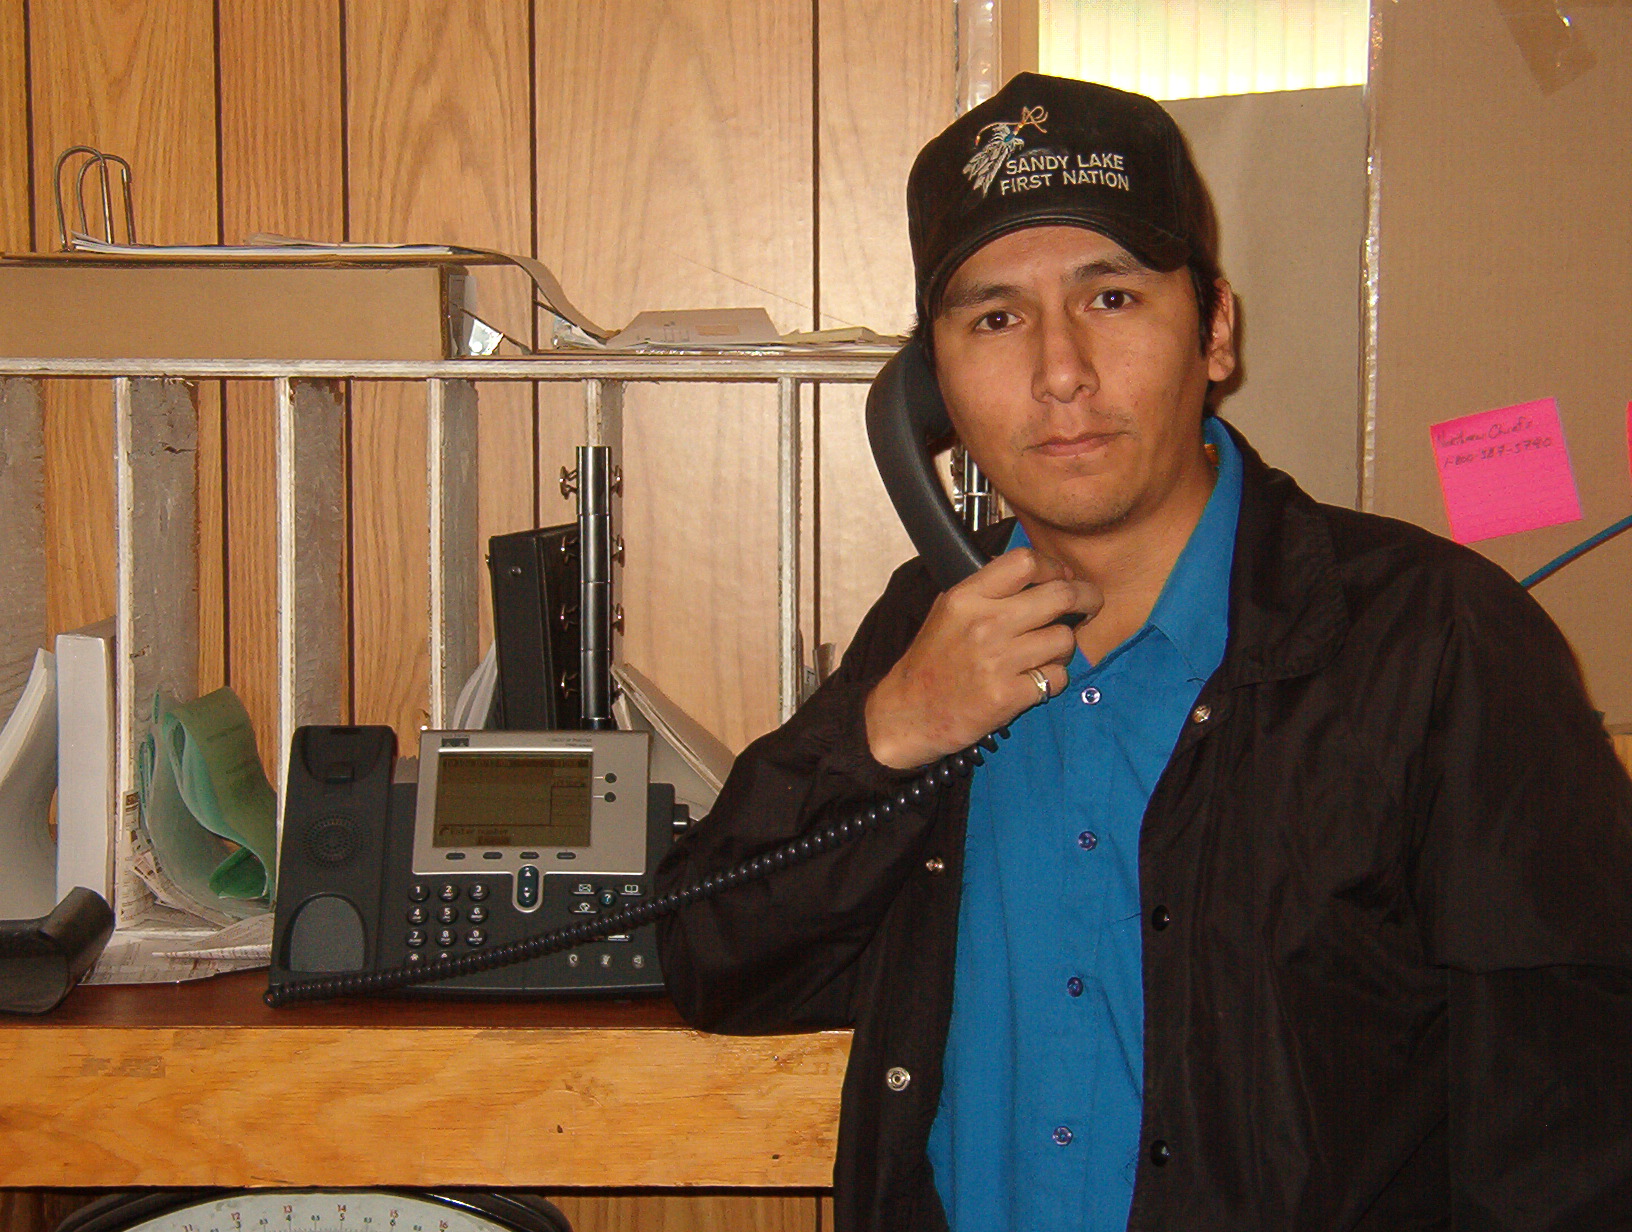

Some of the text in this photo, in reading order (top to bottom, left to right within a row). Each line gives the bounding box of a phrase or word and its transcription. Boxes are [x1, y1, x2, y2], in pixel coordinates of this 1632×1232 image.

[1006, 153, 1124, 174] SANDY LAKE
[1000, 170, 1130, 195] FIRST NATION
